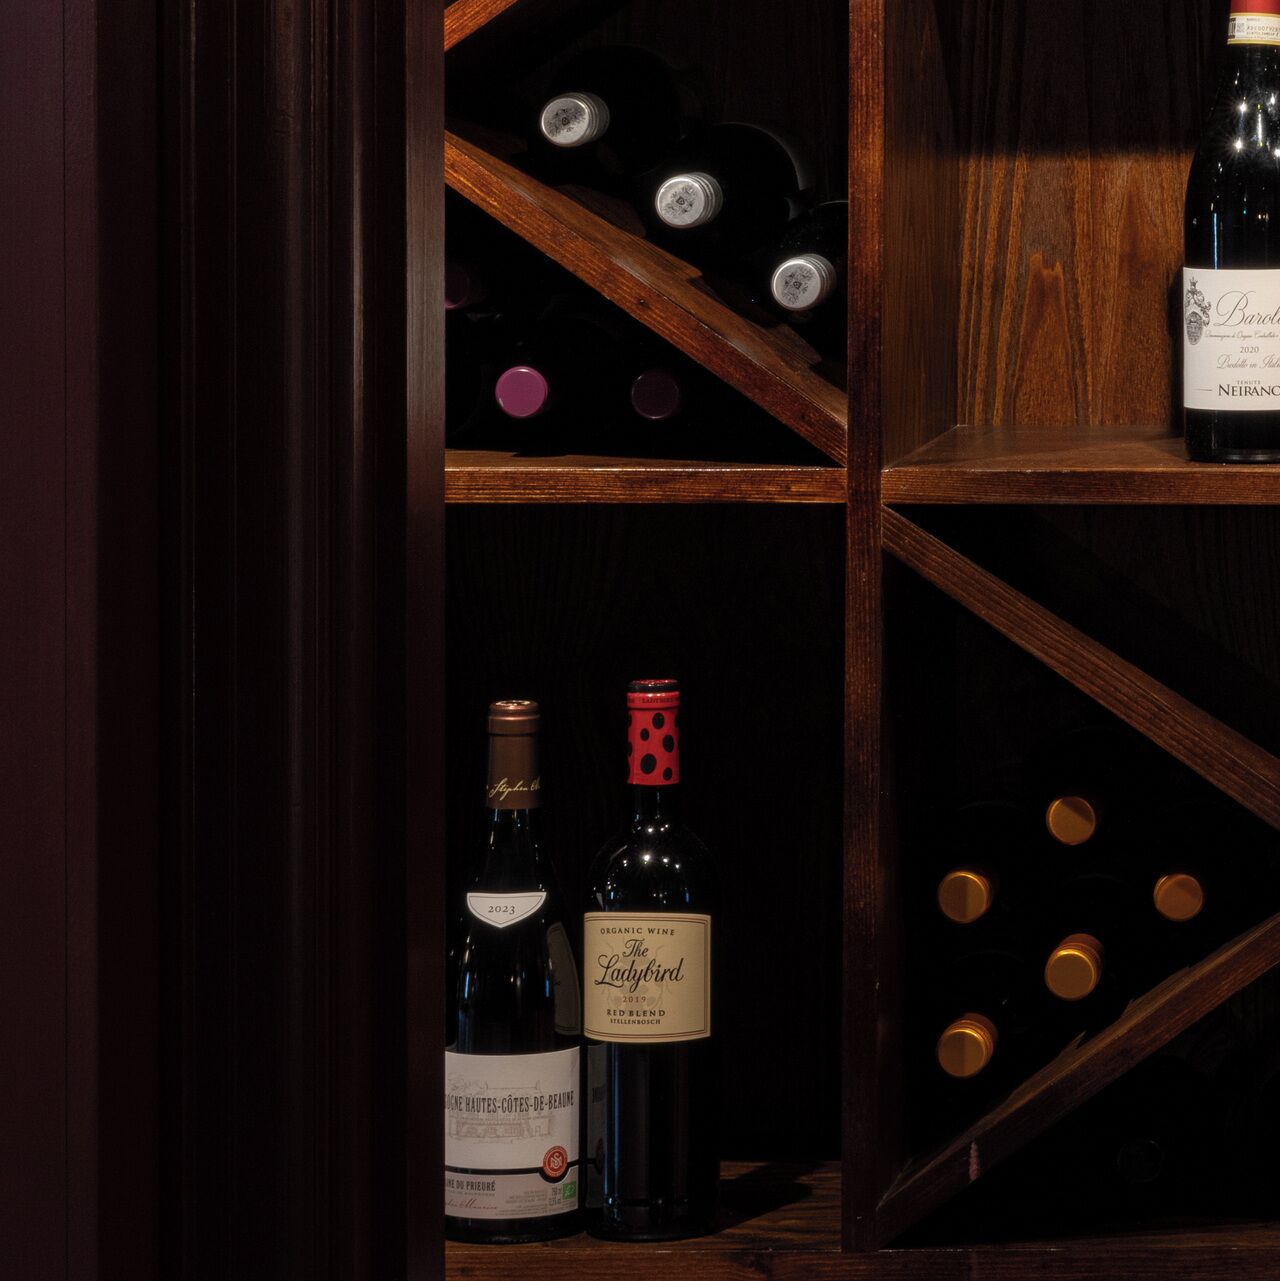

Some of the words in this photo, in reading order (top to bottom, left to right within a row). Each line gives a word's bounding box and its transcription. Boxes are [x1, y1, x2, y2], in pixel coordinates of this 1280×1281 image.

[1239, 346, 1259, 354] 2020
[487, 904, 516, 915] 2023
[600, 927, 643, 935] ORGANIC
[647, 927, 676, 936] WINE
[622, 937, 649, 958] The
[594, 953, 685, 993] Ladybird
[606, 1008, 625, 1017] RED
[628, 1008, 666, 1017] BLEND
[466, 1180, 496, 1192] PRIEURÉ
